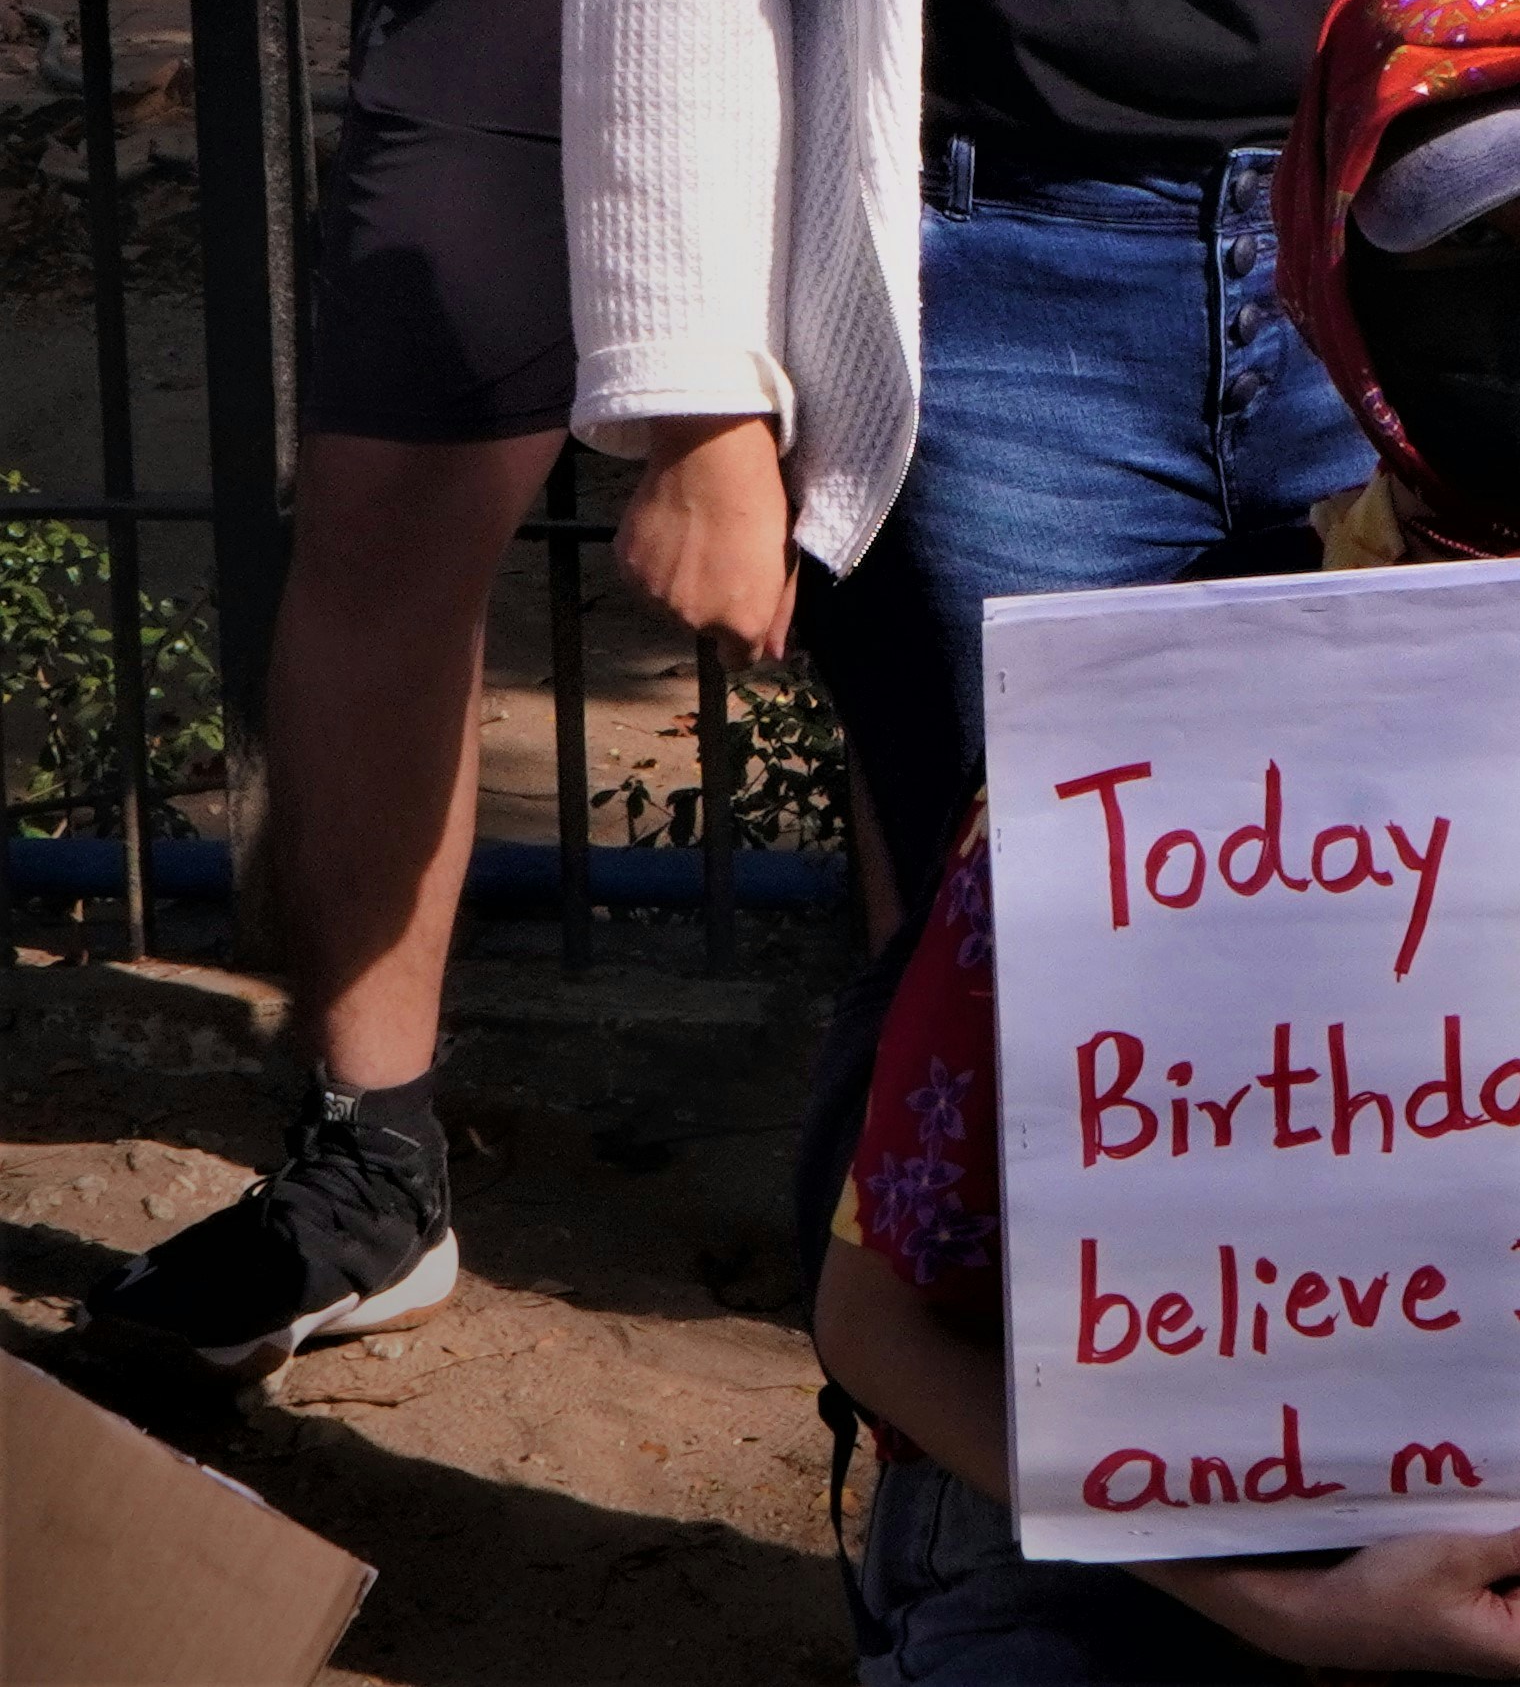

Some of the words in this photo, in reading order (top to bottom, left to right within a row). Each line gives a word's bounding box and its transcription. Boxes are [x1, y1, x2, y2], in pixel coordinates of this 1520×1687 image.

[1053, 760, 1452, 981] Today
[1074, 1237, 1462, 1367] believe
[1082, 1404, 1345, 1514] and
[1389, 1441, 1484, 1494] m
